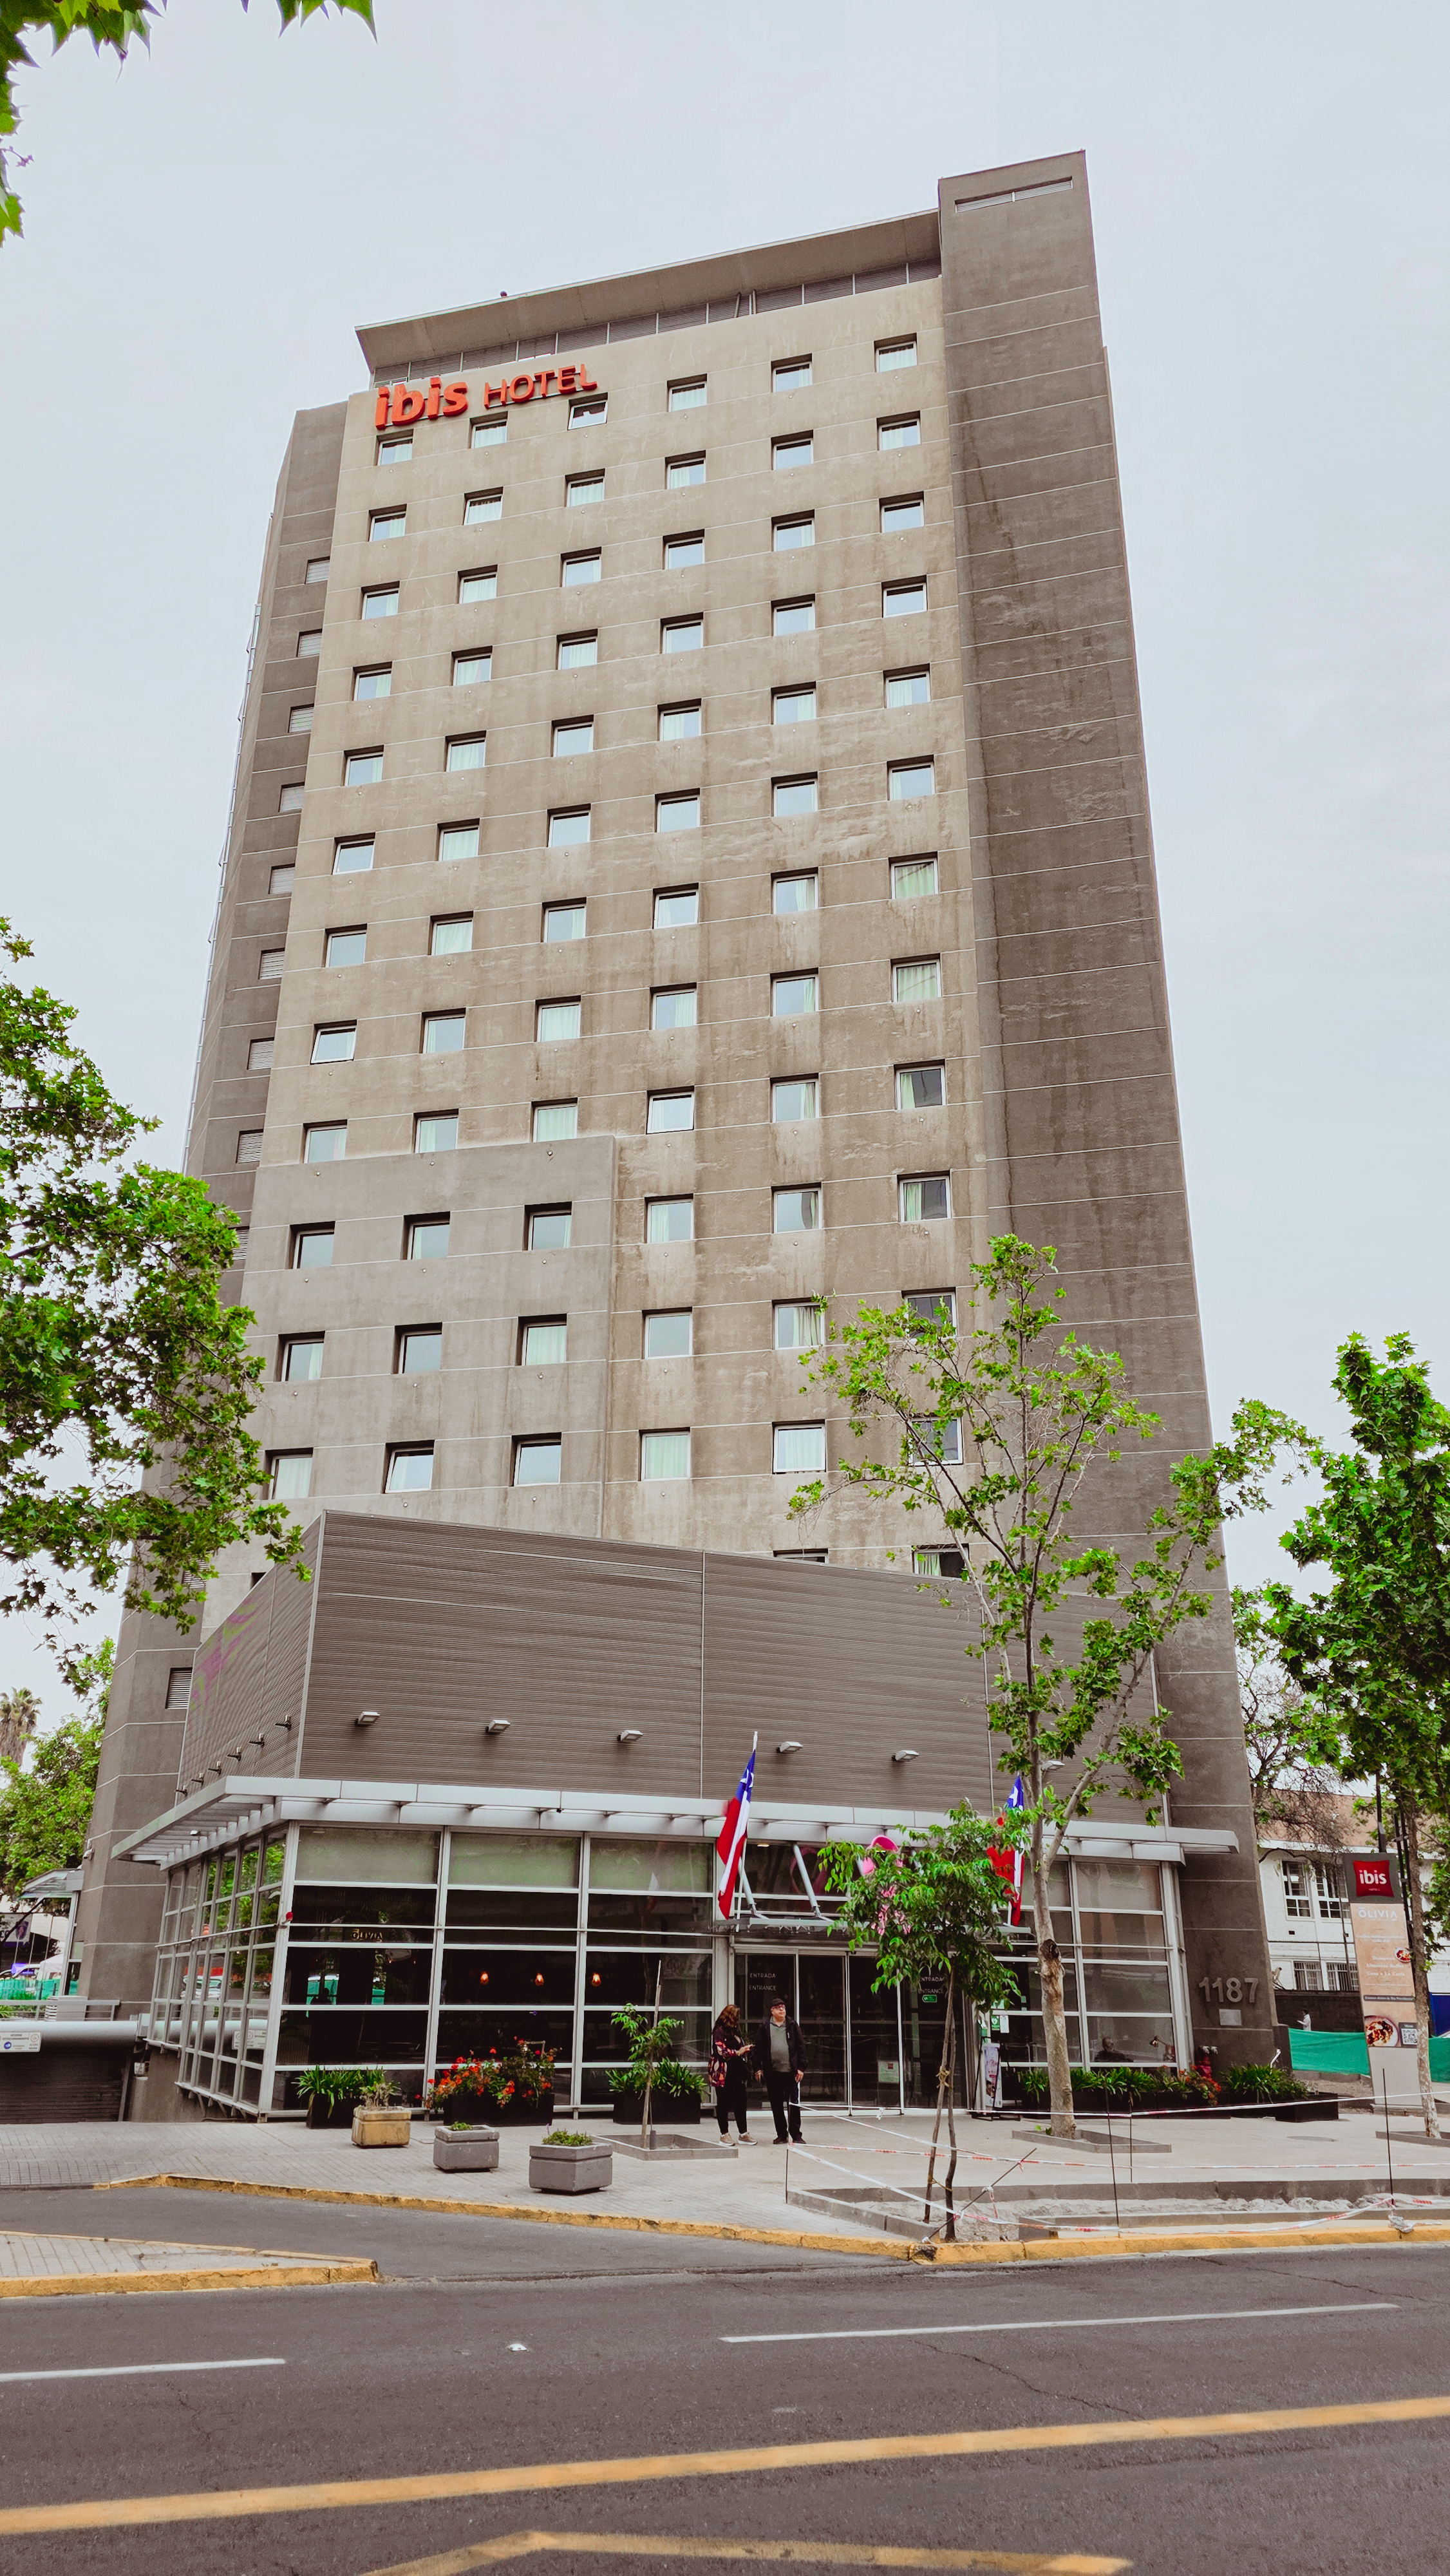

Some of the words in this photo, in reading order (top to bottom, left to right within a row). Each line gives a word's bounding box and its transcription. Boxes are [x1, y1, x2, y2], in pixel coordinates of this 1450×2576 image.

[375, 376, 468, 430] ibis
[484, 363, 598, 409] HOTEL
[1359, 1870, 1387, 1884] ibis
[1198, 1976, 1259, 2003] 1187
